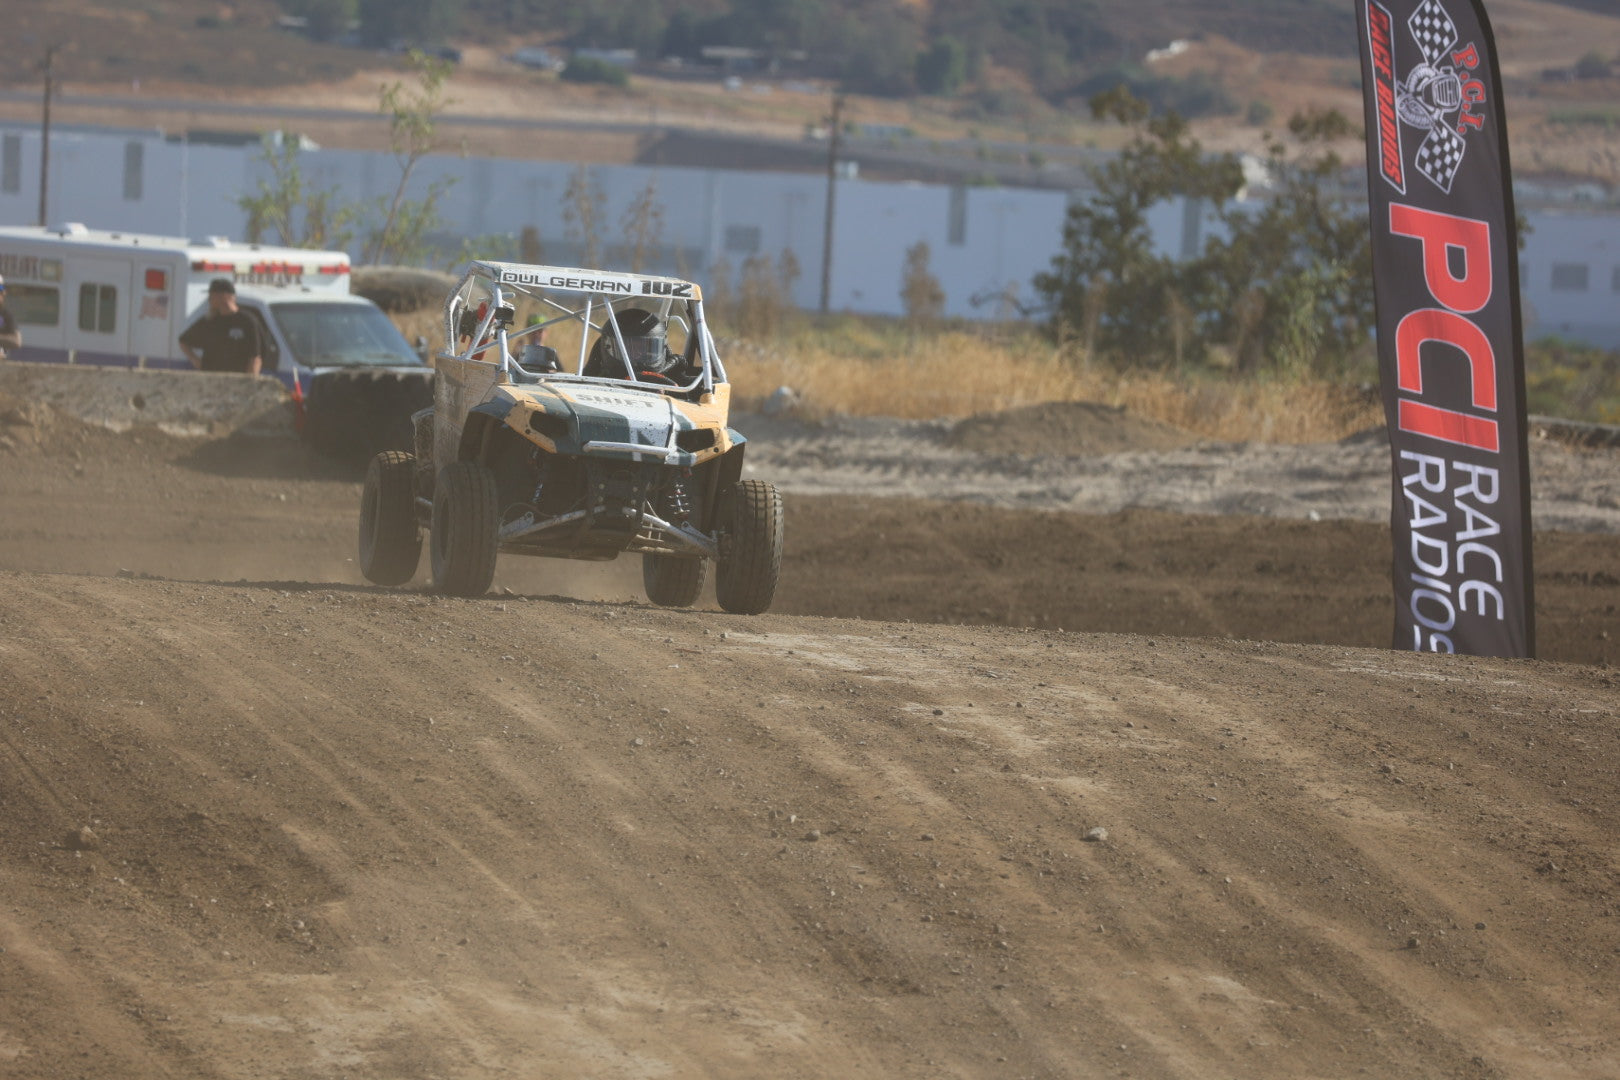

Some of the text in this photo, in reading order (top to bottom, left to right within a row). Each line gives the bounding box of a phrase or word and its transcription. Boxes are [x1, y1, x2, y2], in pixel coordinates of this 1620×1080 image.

[1369, 3, 1402, 184] RACE RADIOS
[640, 280, 692, 297] 102
[1389, 202, 1499, 453] PCI
[1452, 460, 1504, 621] RACE
